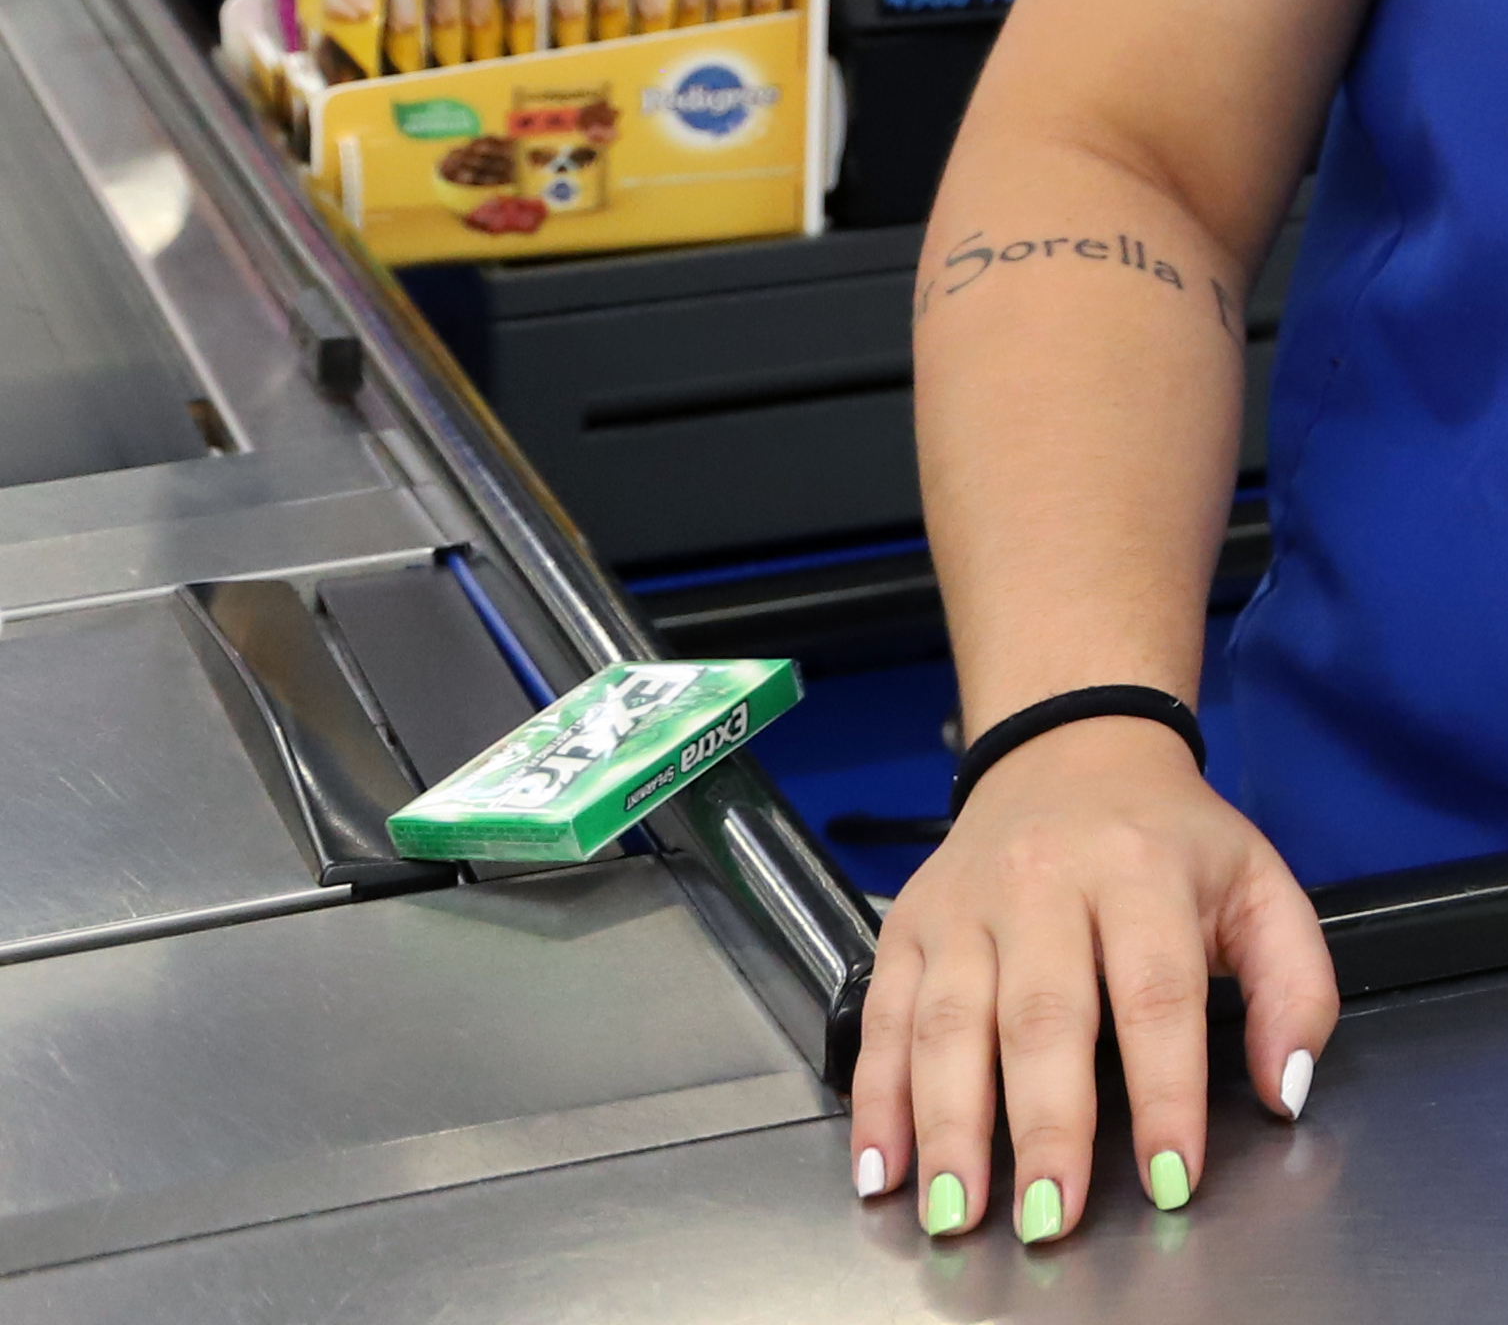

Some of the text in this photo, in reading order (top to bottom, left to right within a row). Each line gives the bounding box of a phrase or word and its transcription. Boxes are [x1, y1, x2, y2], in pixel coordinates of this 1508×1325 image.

[640, 83, 783, 117] Pedigree
[946, 231, 1184, 295] Sorella
[680, 701, 749, 773] Extra
